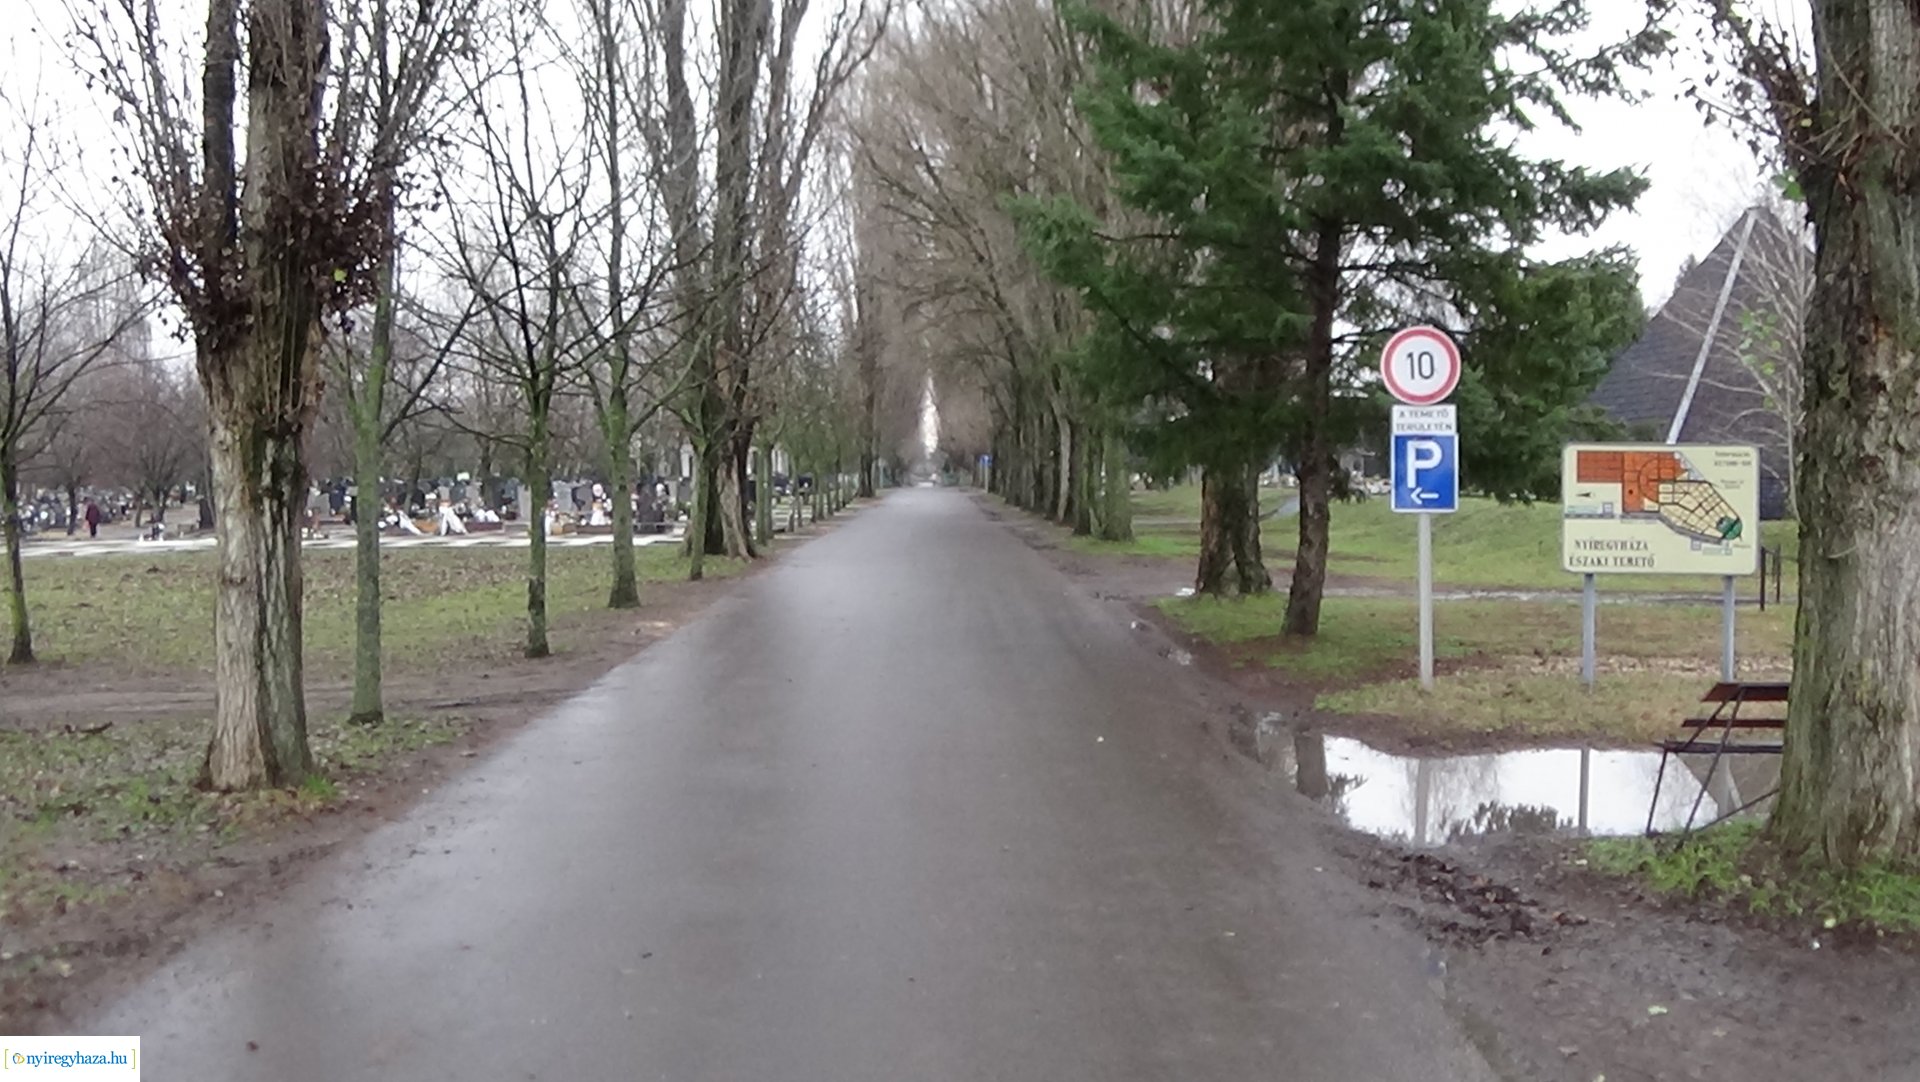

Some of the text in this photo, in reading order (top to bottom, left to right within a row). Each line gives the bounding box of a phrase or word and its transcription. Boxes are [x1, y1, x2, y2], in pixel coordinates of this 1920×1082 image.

[1406, 351, 1434, 380] 10
[1407, 440, 1442, 488] P
[1574, 536, 1649, 551] NYÍREGYHÁZA
[1613, 553, 1655, 568] TEMETŐ
